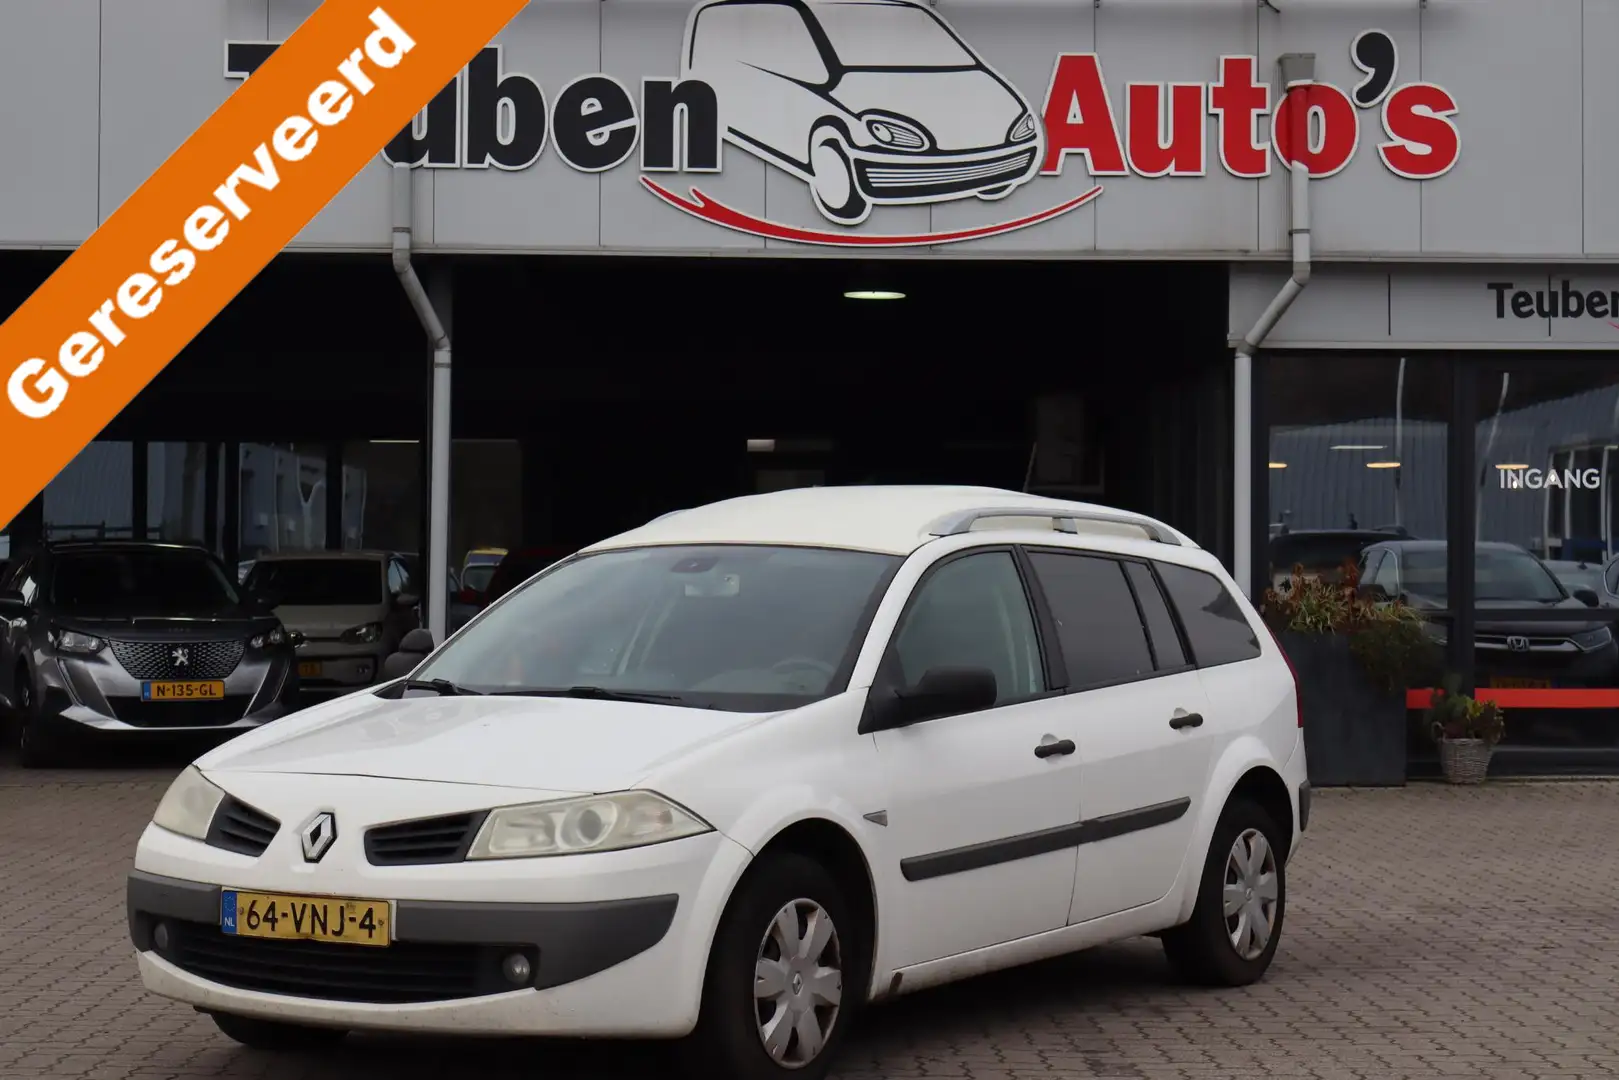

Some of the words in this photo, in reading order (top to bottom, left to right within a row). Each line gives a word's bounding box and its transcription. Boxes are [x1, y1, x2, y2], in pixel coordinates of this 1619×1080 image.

[225, 40, 722, 172] uben
[1040, 29, 1461, 179] Auto's
[1500, 468, 1601, 489] INGANG
[156, 683, 217, 697] N-135-GL
[224, 917, 235, 927] NL
[246, 899, 376, 938] 64-VNJ-4
